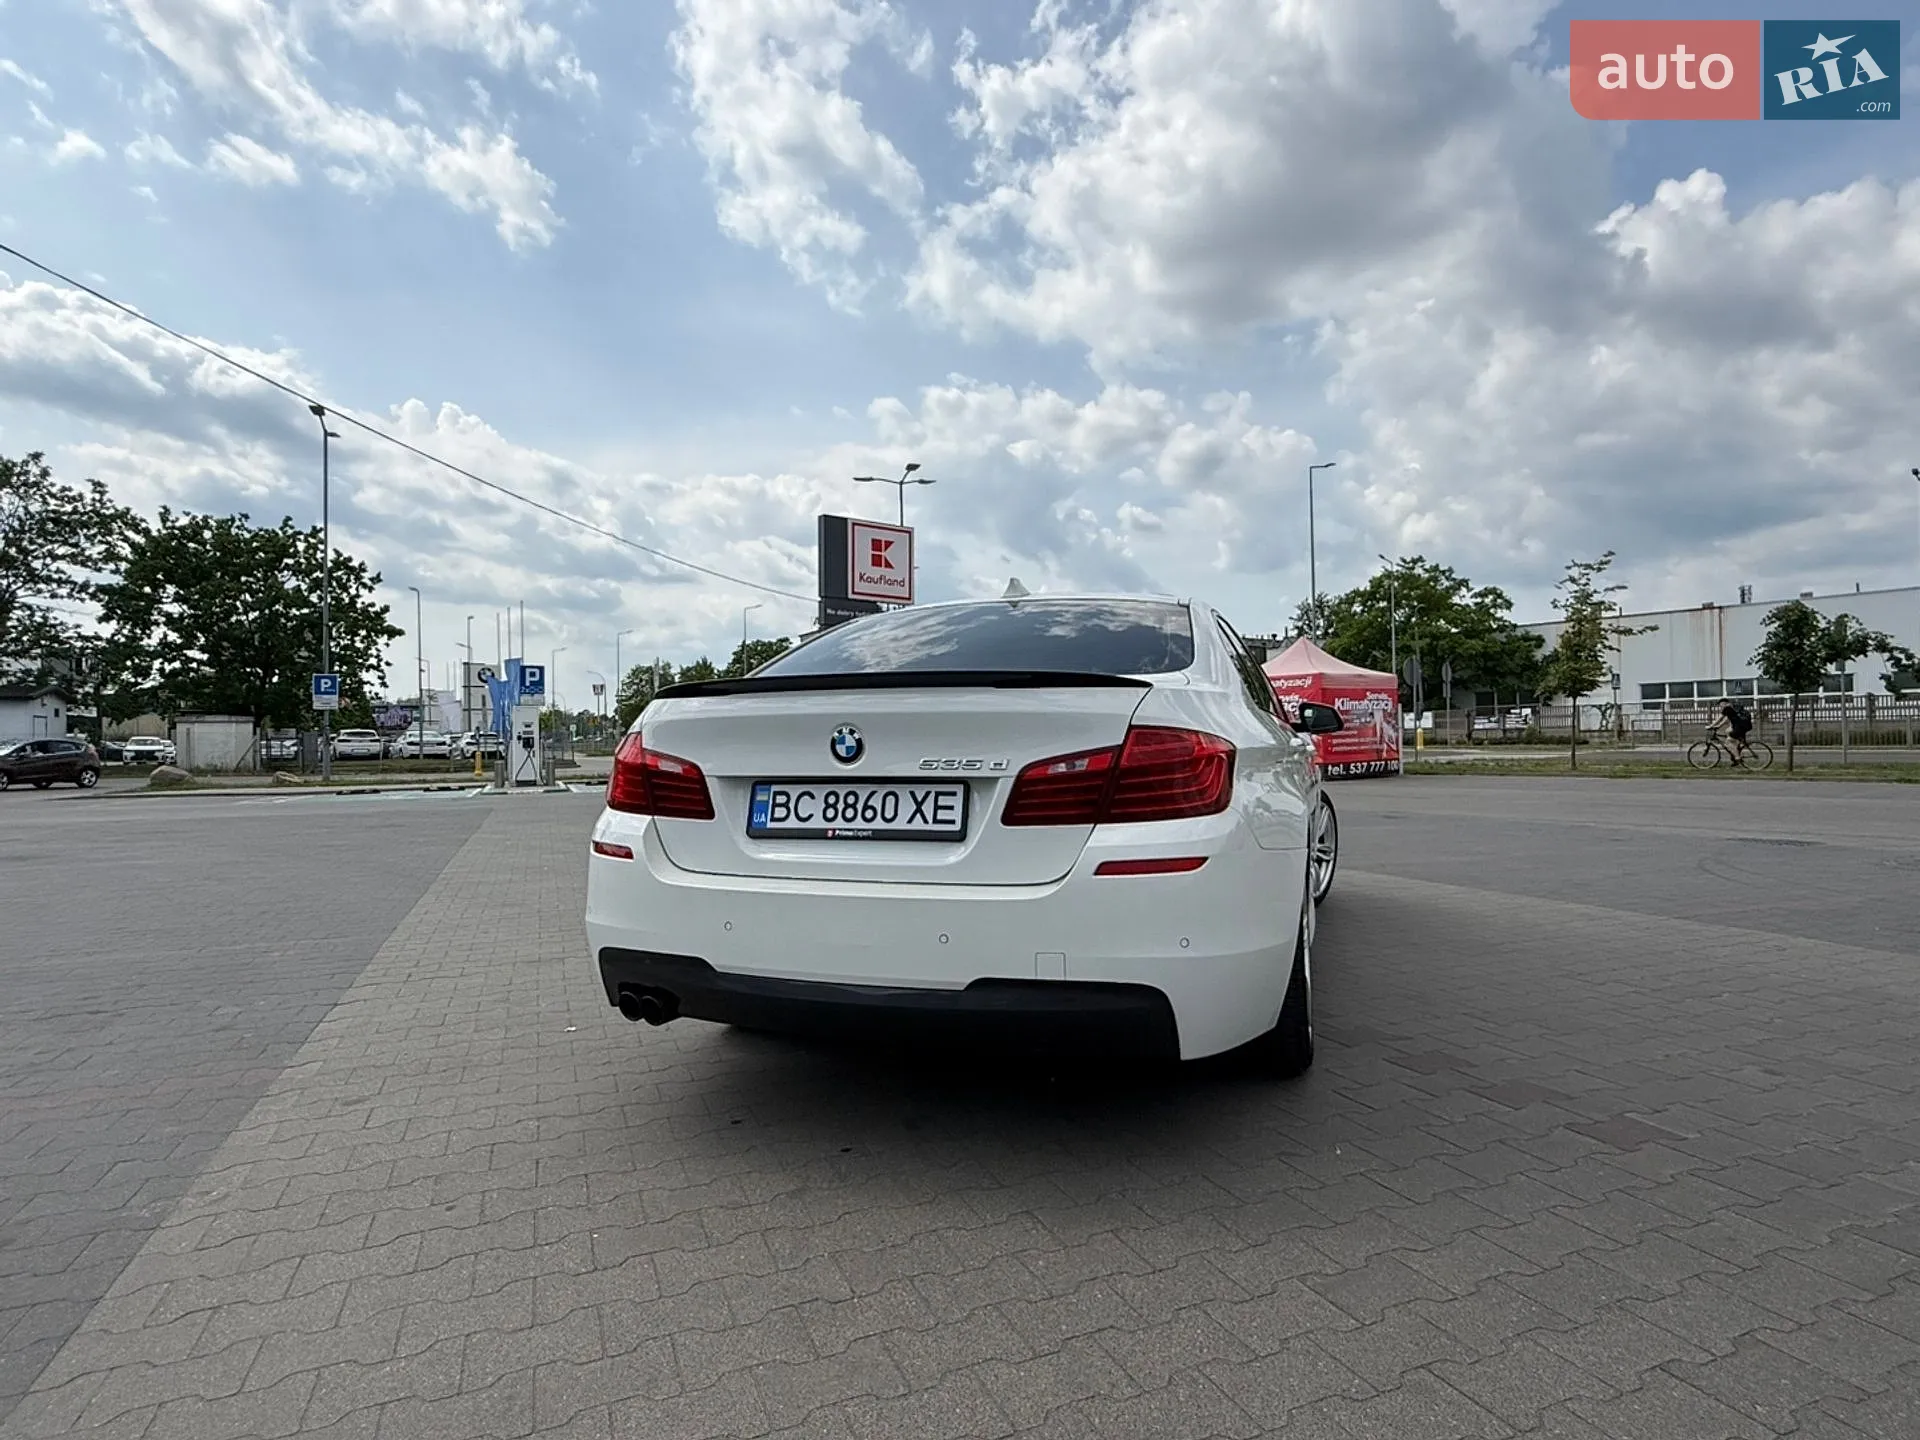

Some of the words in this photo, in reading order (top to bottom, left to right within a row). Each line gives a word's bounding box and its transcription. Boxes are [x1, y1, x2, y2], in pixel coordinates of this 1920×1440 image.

[858, 571, 906, 588] Kaufland
[525, 667, 540, 686] P
[1270, 676, 1312, 689] atyzacji
[320, 678, 332, 692] P
[1327, 763, 1346, 776] tel.
[1349, 761, 1368, 774] 537
[1369, 760, 1386, 773] 777
[770, 790, 816, 823] BC
[822, 790, 899, 824] 8860
[906, 790, 958, 825] XE
[753, 813, 767, 823] UA
